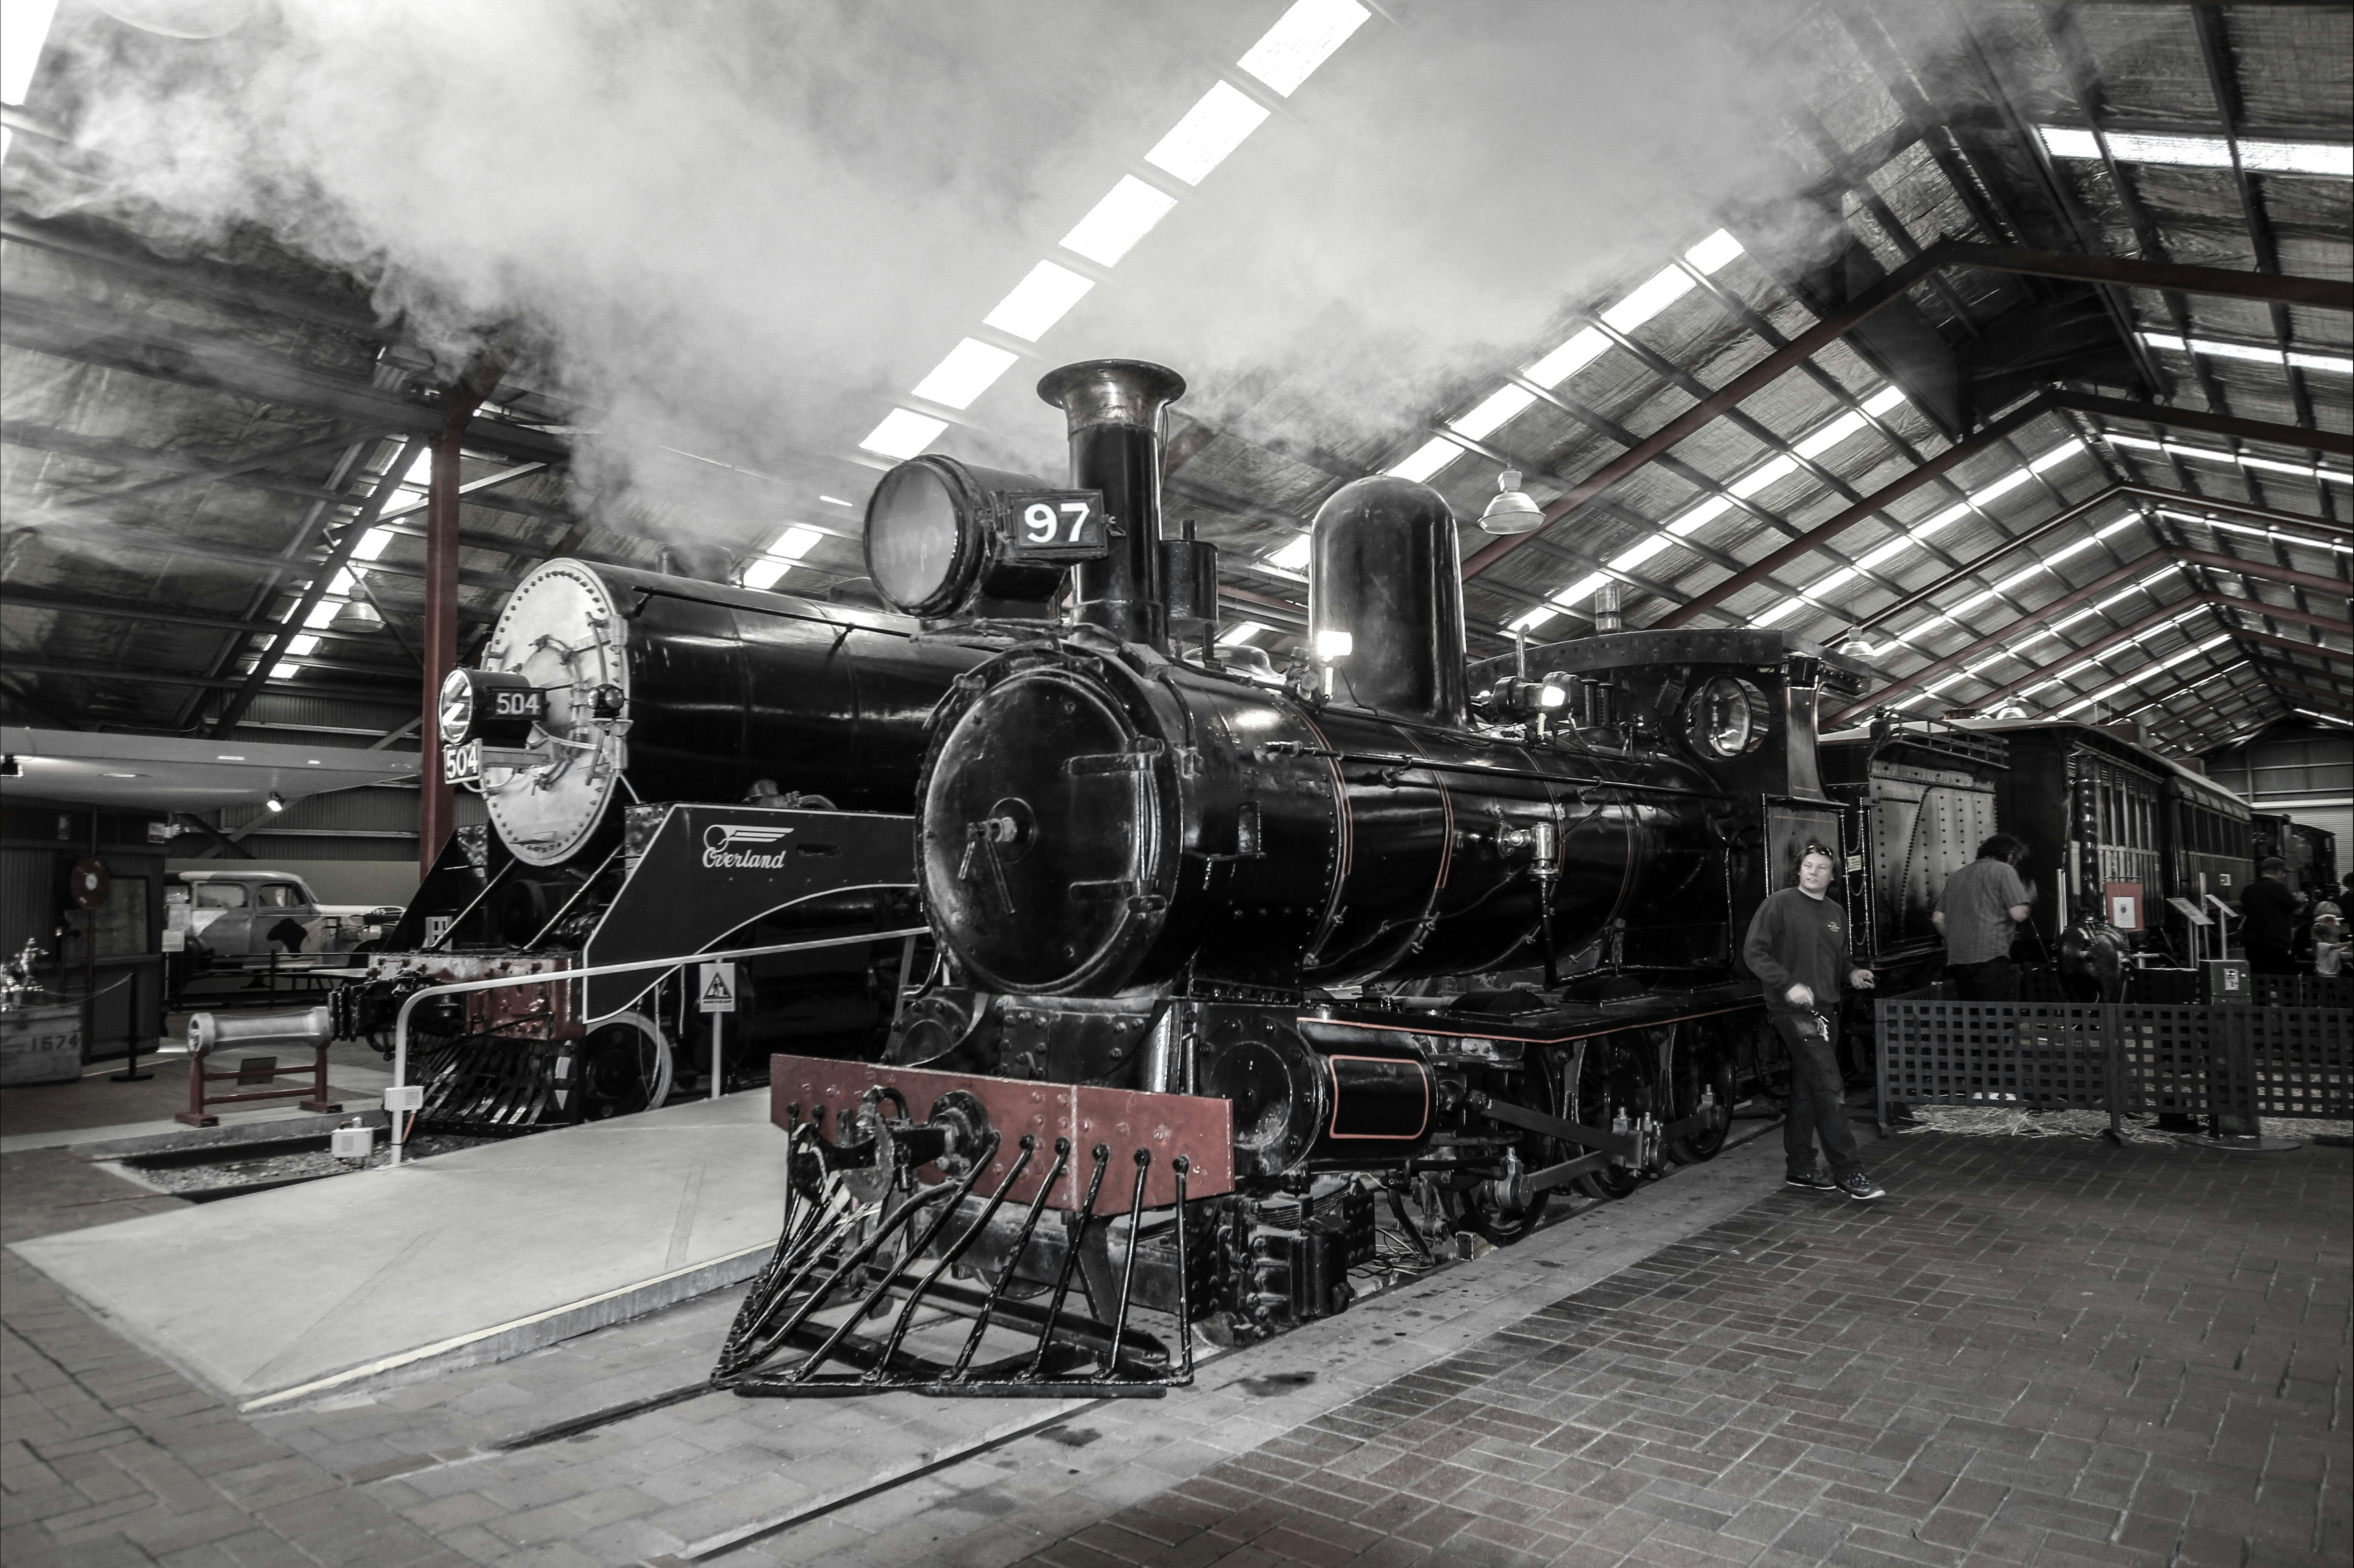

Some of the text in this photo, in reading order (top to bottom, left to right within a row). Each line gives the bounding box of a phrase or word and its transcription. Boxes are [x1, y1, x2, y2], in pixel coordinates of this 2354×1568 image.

[1024, 502, 1091, 544] 97
[496, 693, 541, 715] 504
[446, 746, 478, 779] 504
[702, 847, 787, 869] Overland
